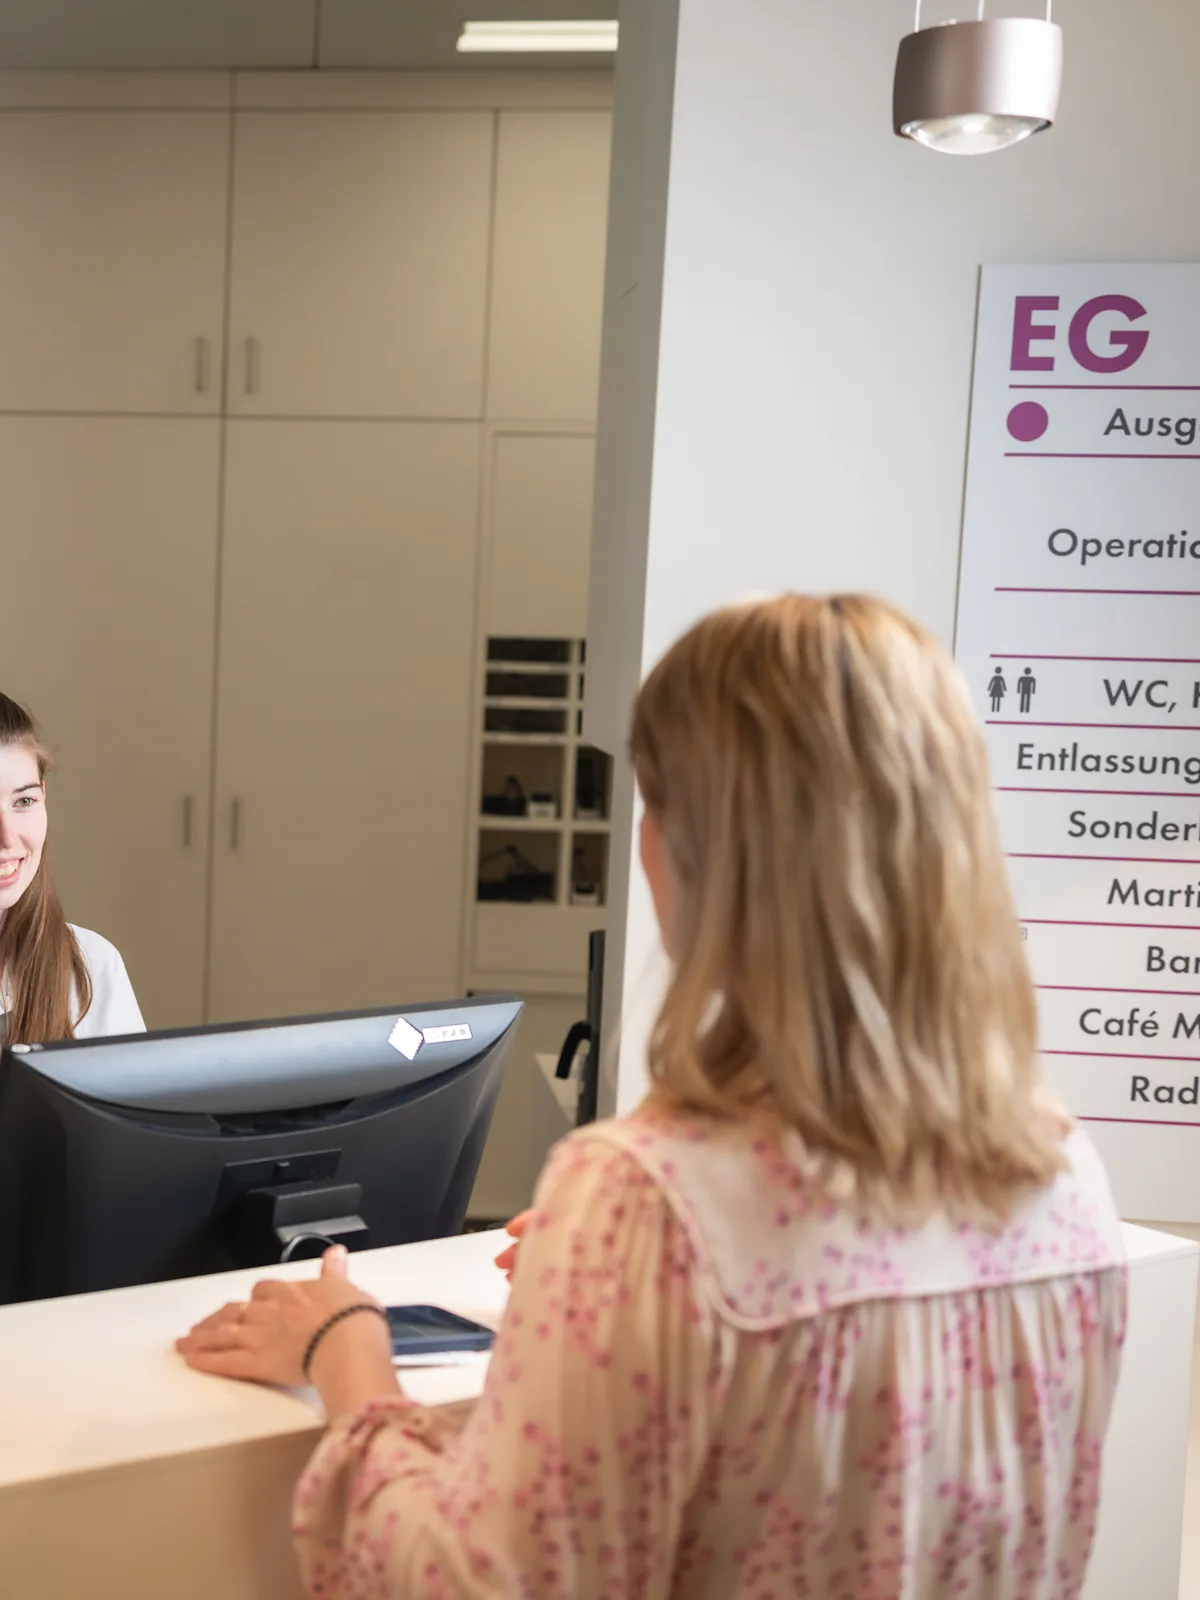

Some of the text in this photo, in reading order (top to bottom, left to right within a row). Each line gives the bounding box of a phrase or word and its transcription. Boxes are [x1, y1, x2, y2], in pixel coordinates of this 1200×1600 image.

[1010, 294, 1150, 373] EG
[1103, 407, 1200, 446] Ausg
[1103, 678, 1177, 713] WC,
[1017, 741, 1200, 785] Entlassung
[1067, 810, 1200, 842] Sonder
[1079, 1007, 1160, 1038] Café
[1130, 1075, 1200, 1105] Rad
